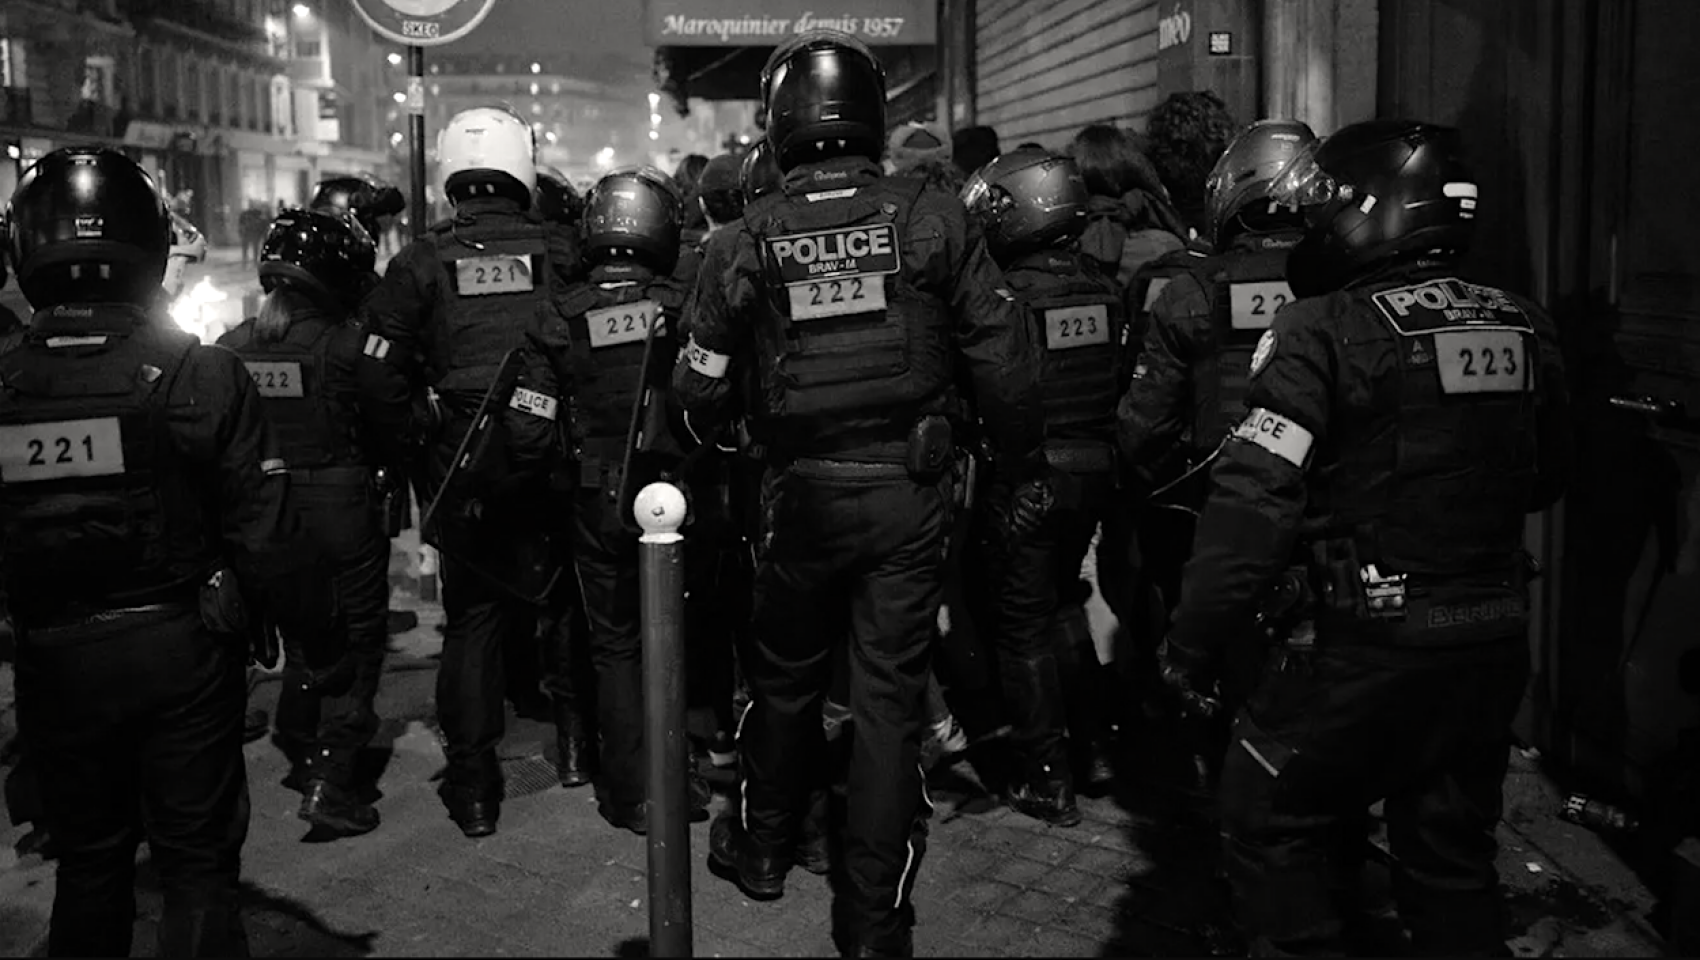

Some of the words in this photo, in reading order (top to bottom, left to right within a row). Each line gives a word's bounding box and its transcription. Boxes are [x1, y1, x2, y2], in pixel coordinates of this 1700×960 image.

[661, 15, 790, 42] Maroquinier
[861, 17, 904, 38] 1957
[772, 228, 892, 267] POLICE
[475, 265, 515, 284] 221
[809, 278, 865, 305] 222
[607, 312, 647, 334] 221
[1060, 317, 1097, 337] 223
[1460, 348, 1516, 376] 223
[252, 371, 289, 388] 222
[28, 435, 93, 466] 221
